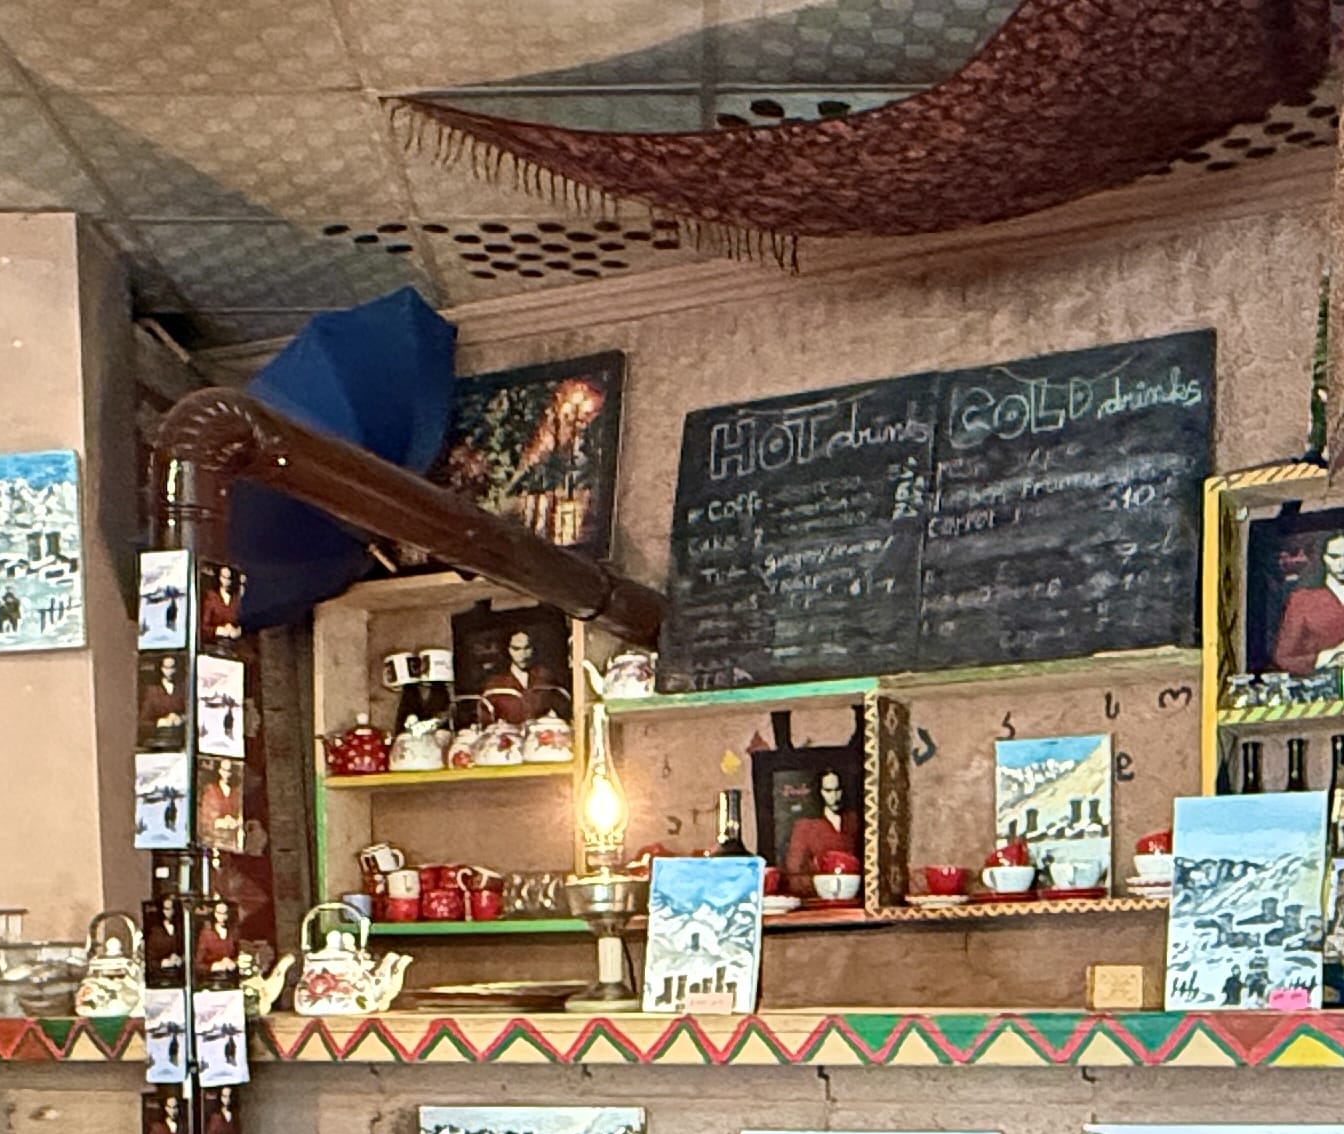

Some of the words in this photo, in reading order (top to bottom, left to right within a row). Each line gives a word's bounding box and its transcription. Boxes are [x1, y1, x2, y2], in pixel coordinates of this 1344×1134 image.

[709, 403, 836, 480] HOT
[950, 377, 1093, 449] COLD
[1098, 366, 1202, 420] drinks
